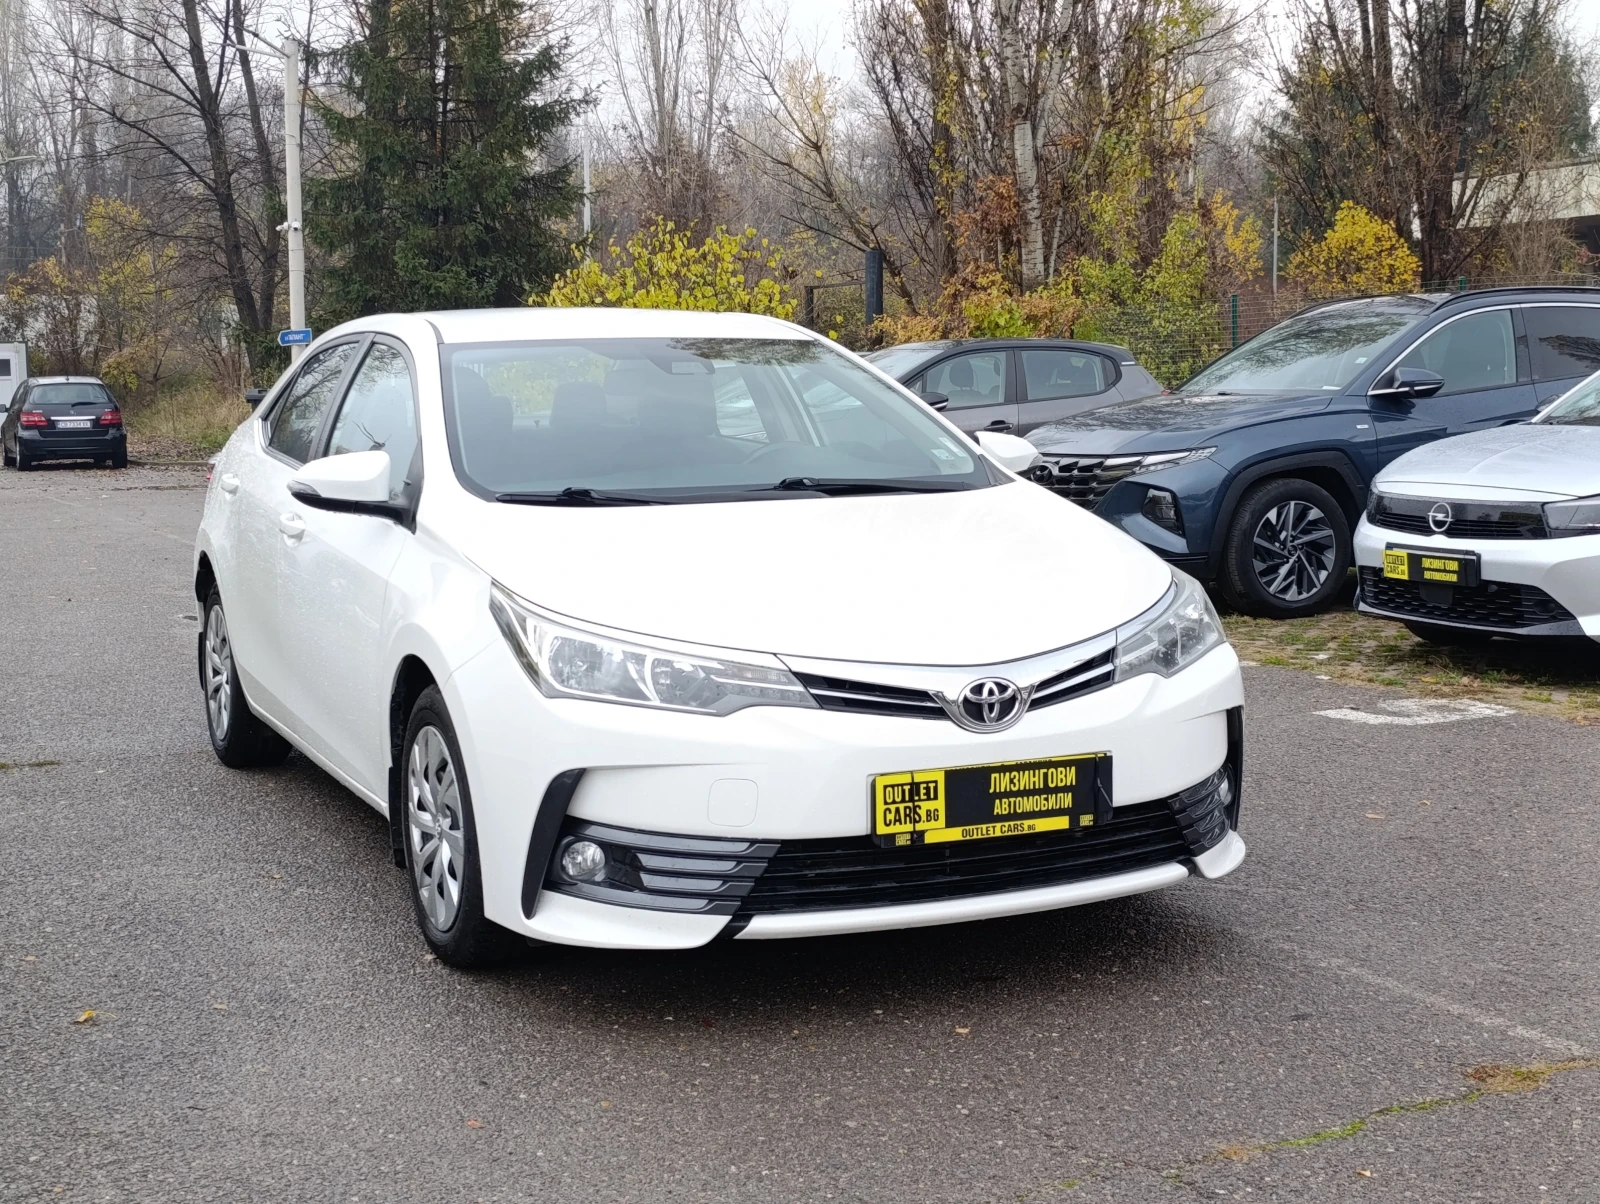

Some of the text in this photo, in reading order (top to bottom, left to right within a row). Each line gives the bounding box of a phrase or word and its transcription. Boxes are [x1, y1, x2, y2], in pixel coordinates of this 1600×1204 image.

[1386, 556, 1405, 565] OUTLET
[1421, 557, 1458, 571] ЛИЗИНГОВИ
[1424, 571, 1458, 582] АВТОМОБИЛИ
[989, 767, 1076, 793] ЛИЗИНГОВИ
[994, 793, 1072, 815] АВТОМОБИЛИ
[884, 804, 940, 828] CARS.BG
[961, 827, 996, 839] OUTLET
